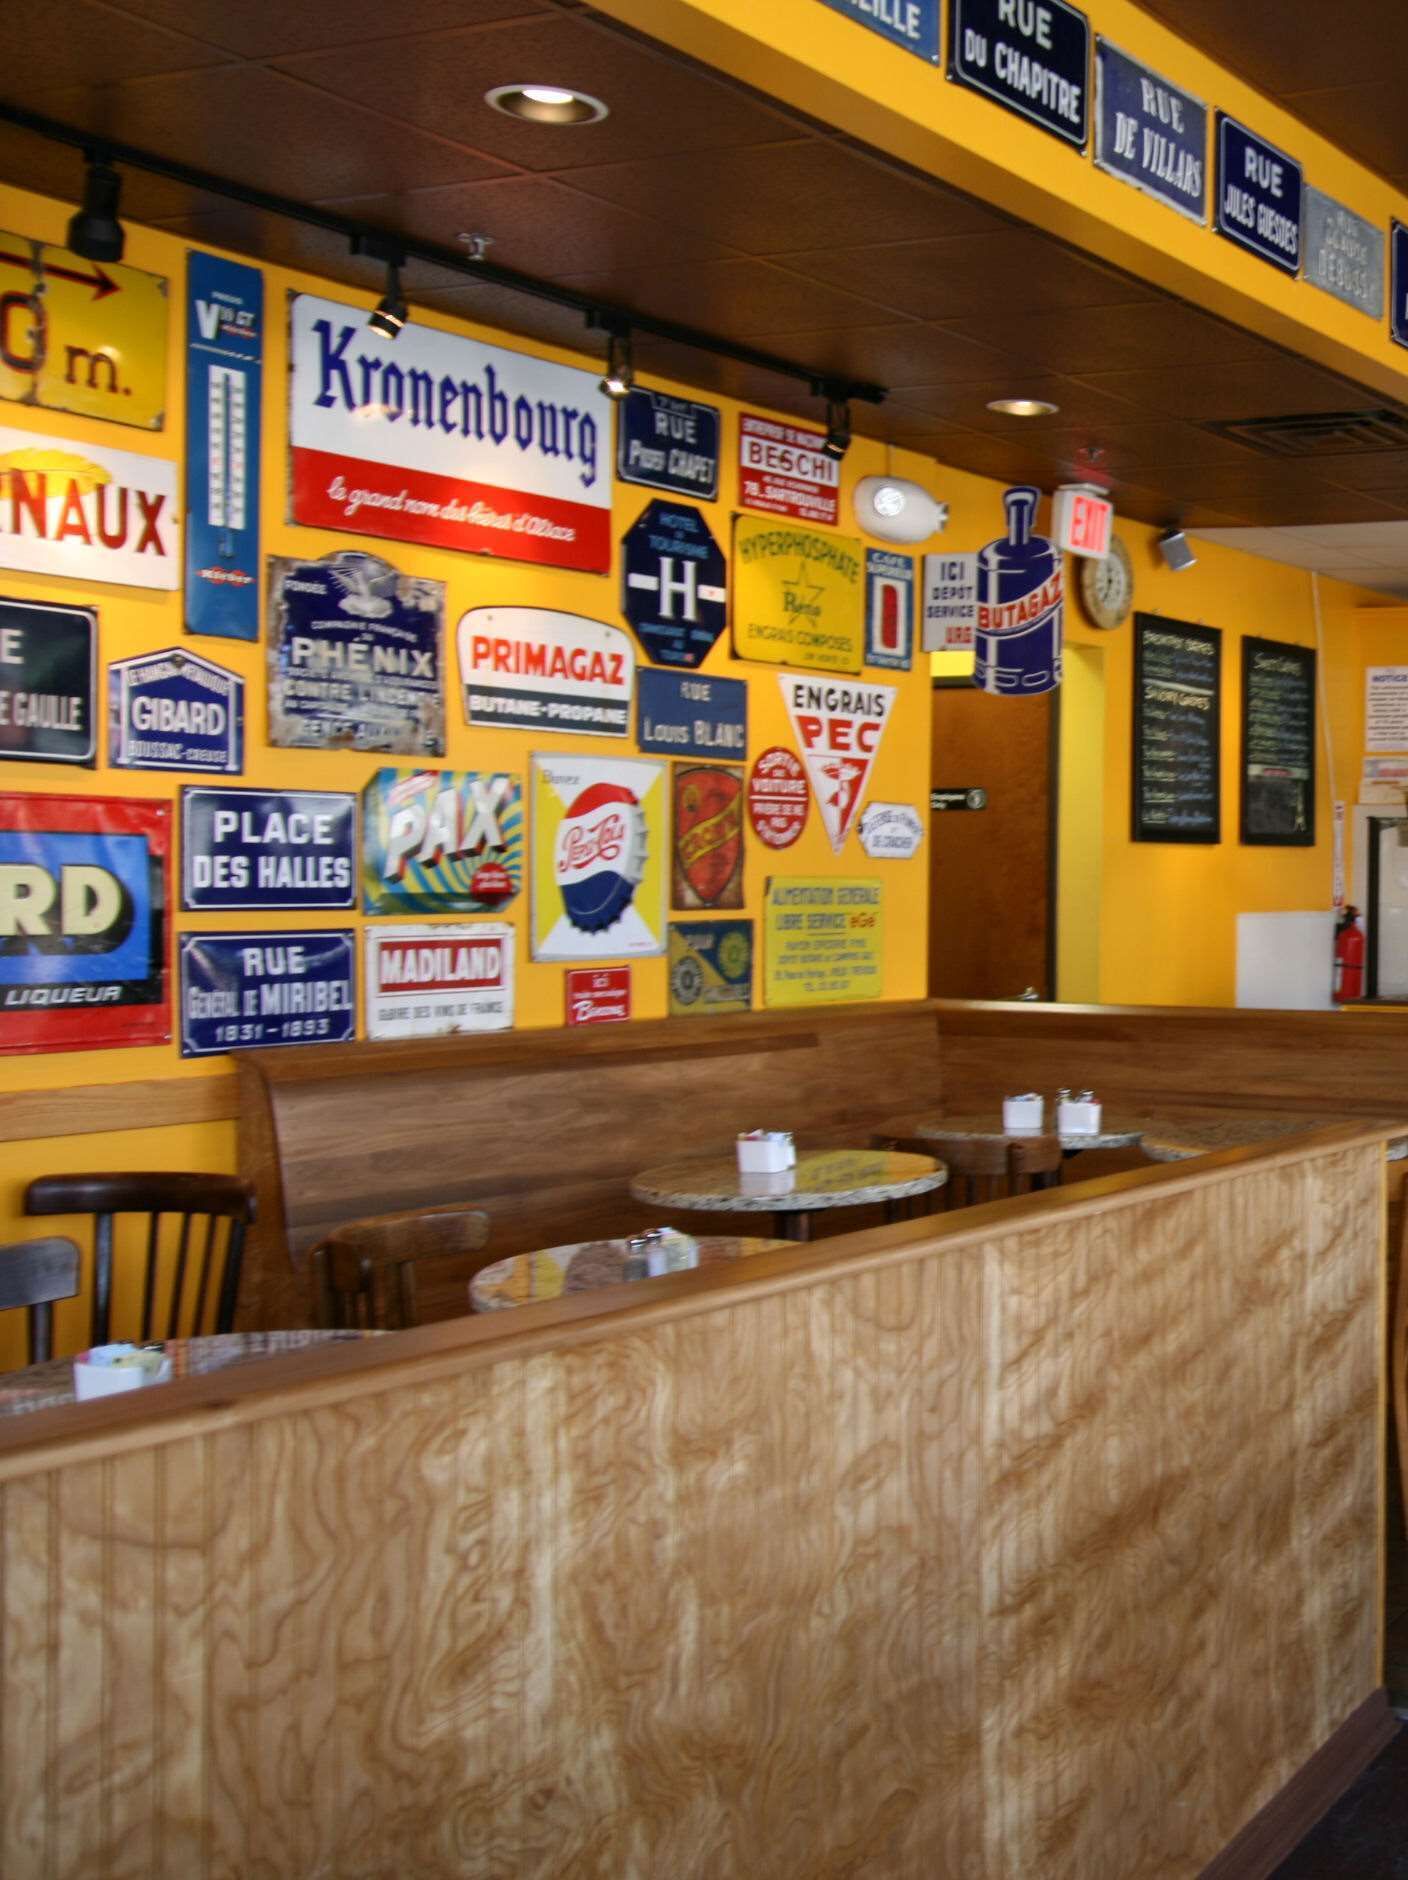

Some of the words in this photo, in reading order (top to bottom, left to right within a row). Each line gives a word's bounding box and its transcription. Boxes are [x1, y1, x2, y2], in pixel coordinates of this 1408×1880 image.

[999, 0, 1052, 49] RUE
[965, 28, 987, 67] DU
[995, 42, 1080, 123] CHAPITRE
[1140, 77, 1184, 134] RUE
[1114, 112, 1138, 160] DE
[1143, 127, 1202, 197] VILLARS
[1245, 147, 1283, 198] RUE
[1224, 184, 1256, 228] JULES
[312, 319, 598, 487] Kronenbourg
[655, 412, 697, 444] RUE
[749, 441, 834, 482] BESCHI
[0, 467, 167, 557] NAUX
[344, 489, 408, 516] grand
[1070, 496, 1109, 554] EXIT
[659, 557, 698, 622] H
[940, 561, 964, 581] ICI
[927, 605, 974, 618] SERVICE
[978, 573, 1063, 630] BUTAGAZ
[471, 635, 624, 685] PRIMAGAZ
[1371, 675, 1408, 683] NOTICE
[681, 681, 711, 702] RUE
[793, 684, 886, 717] ENGRAIS
[132, 696, 226, 736] GIBARD
[795, 714, 882, 753] PEC
[213, 810, 336, 845] PLACE
[383, 776, 511, 881] PAX
[193, 855, 250, 888] DES
[257, 856, 351, 888] HALLES
[243, 946, 307, 976] RUE
[4, 986, 122, 1006] LIQUEUR
[260, 980, 353, 1016] MIRIBEL
